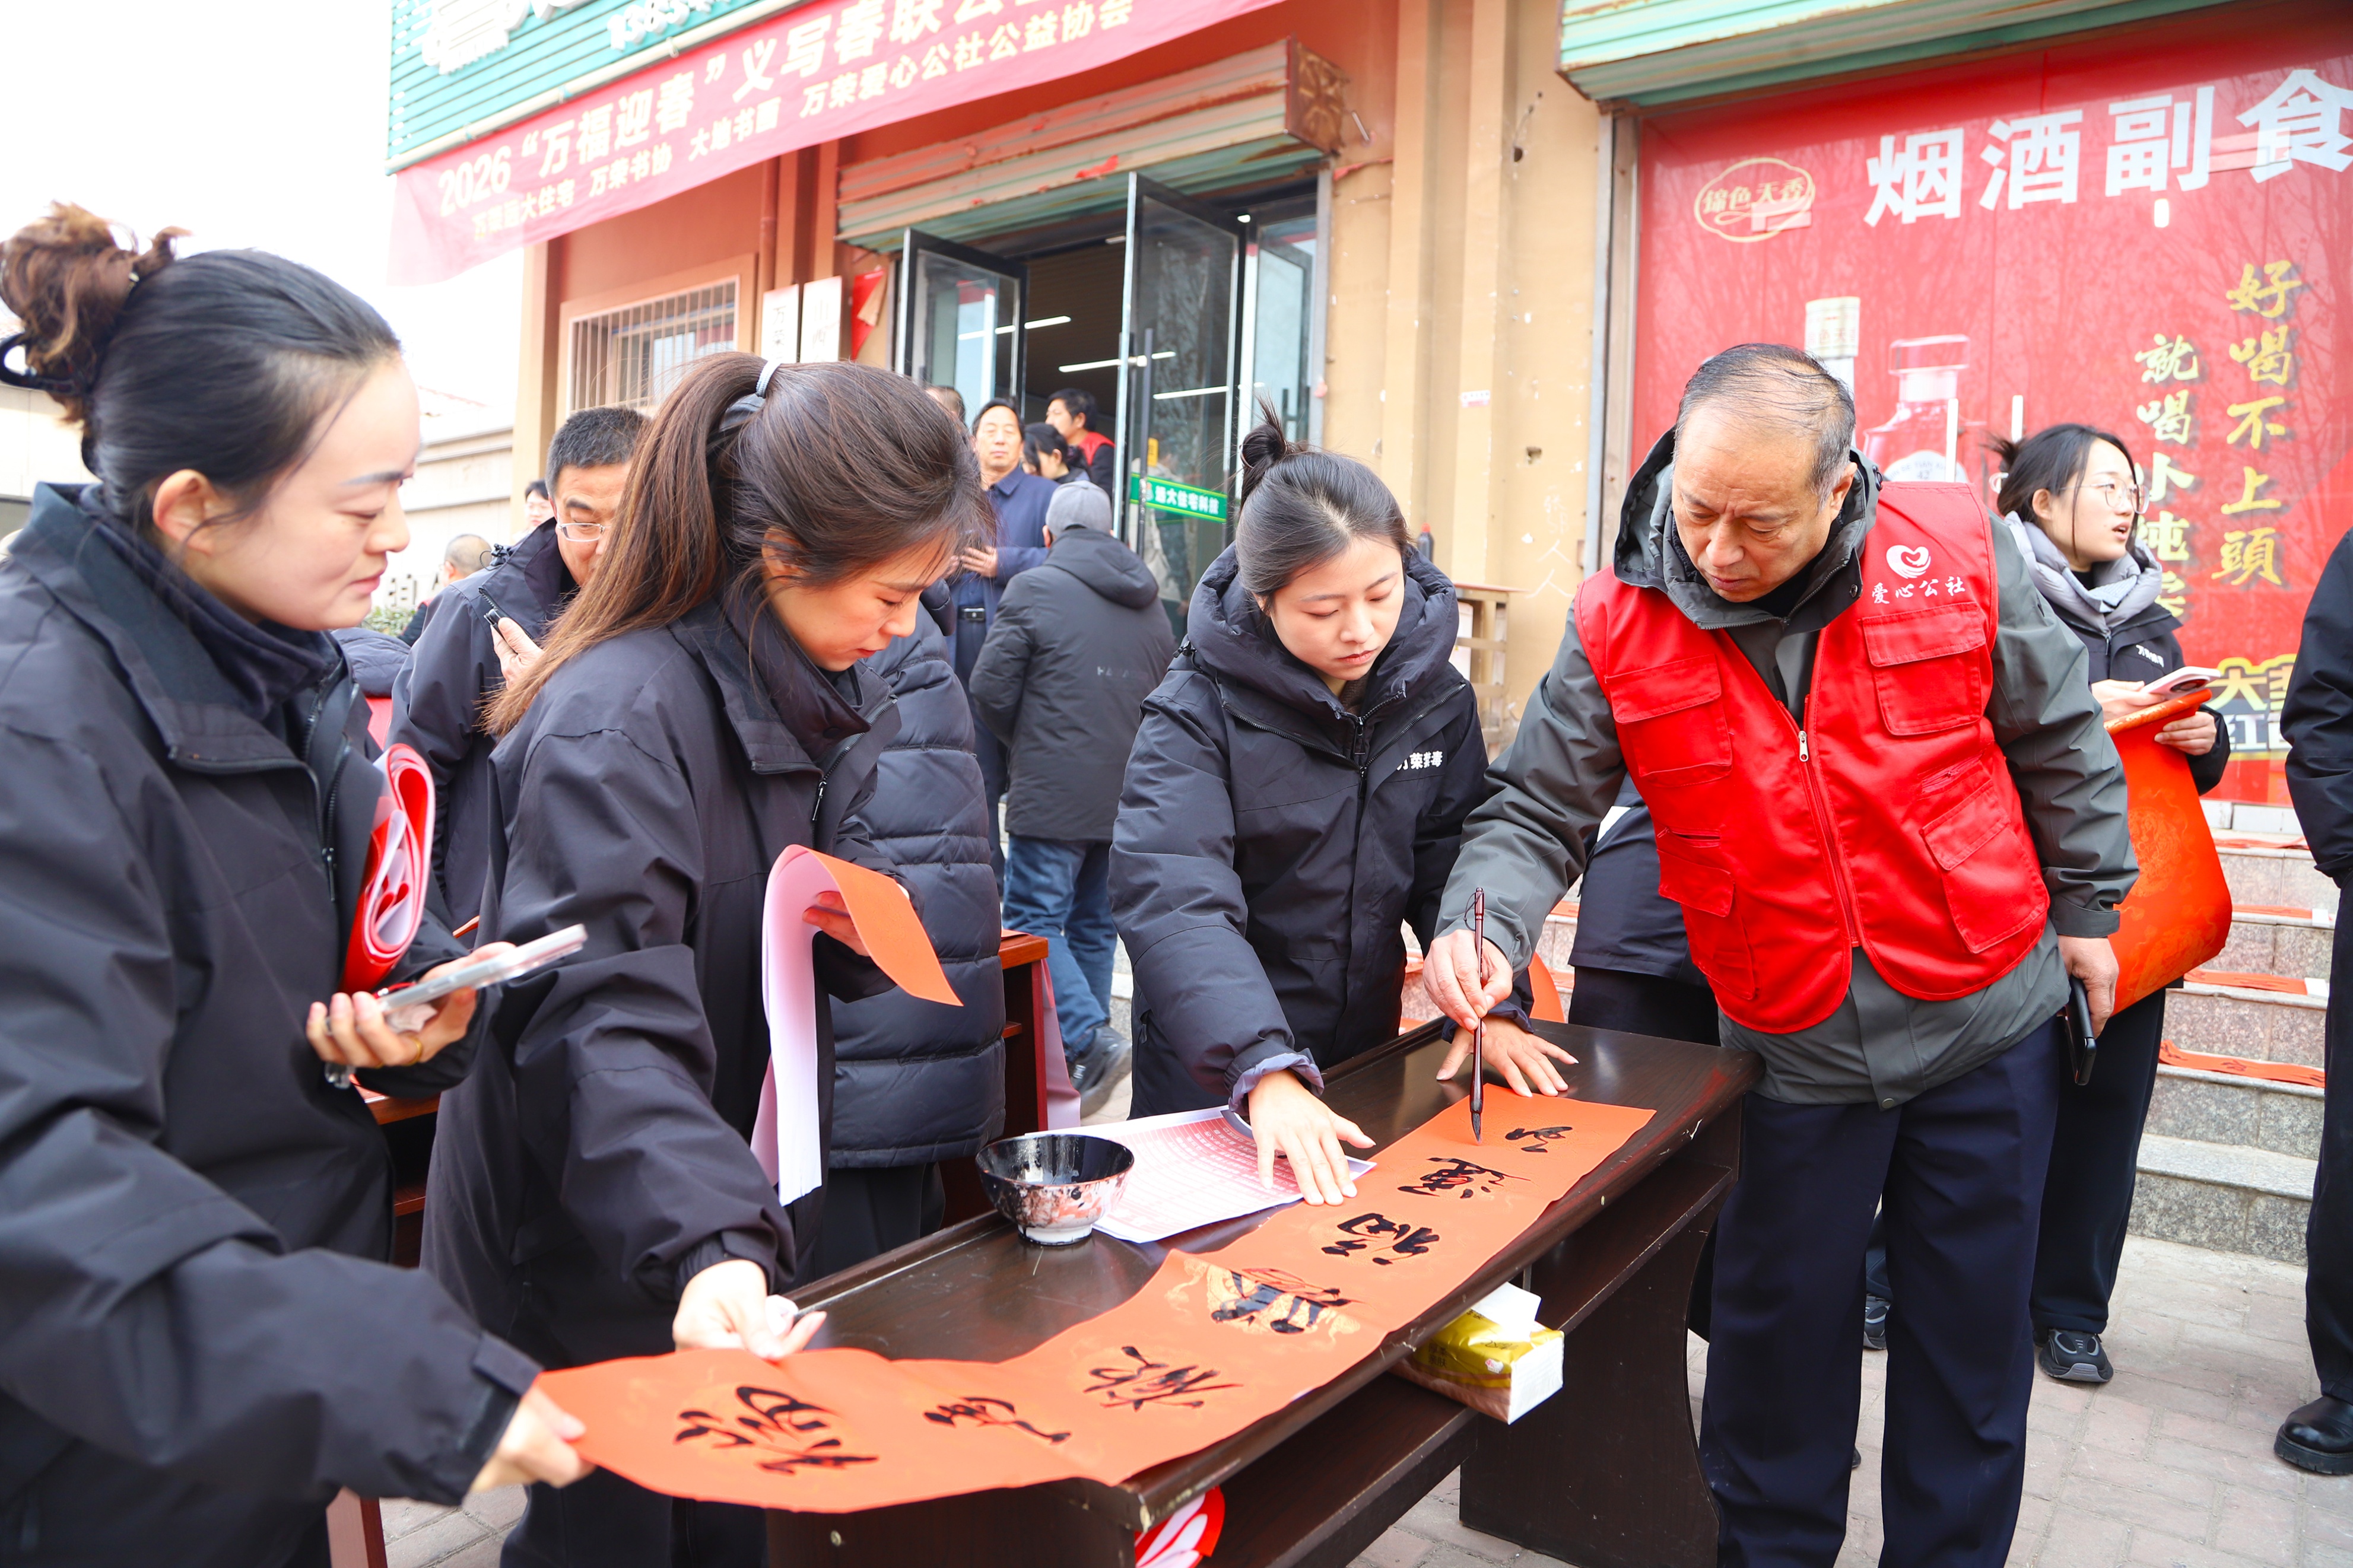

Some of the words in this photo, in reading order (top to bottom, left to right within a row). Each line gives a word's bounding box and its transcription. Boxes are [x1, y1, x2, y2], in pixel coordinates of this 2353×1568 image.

[1864, 69, 2353, 228] 烟酒副食
[1871, 575, 1966, 605] 爱心公社
